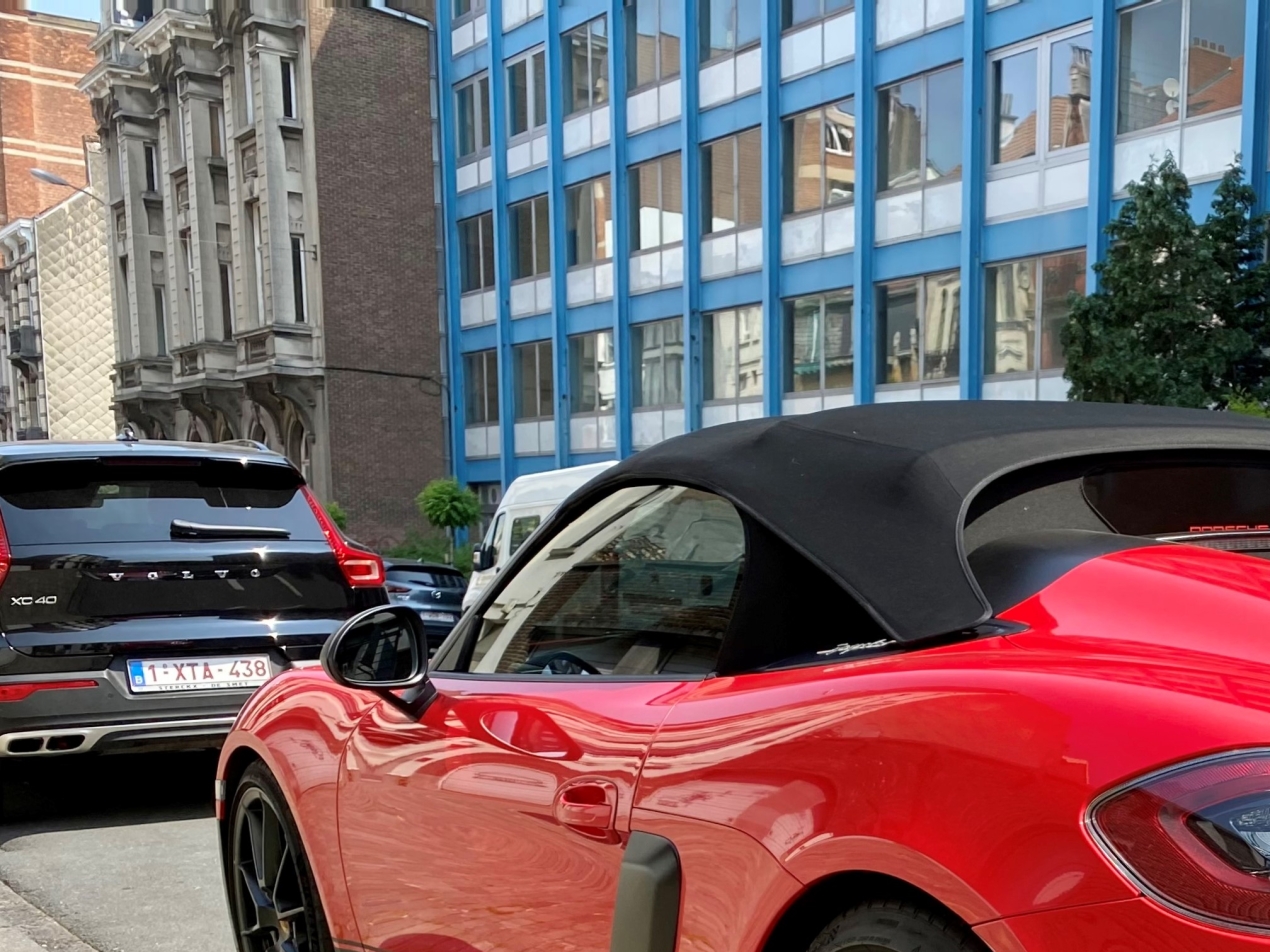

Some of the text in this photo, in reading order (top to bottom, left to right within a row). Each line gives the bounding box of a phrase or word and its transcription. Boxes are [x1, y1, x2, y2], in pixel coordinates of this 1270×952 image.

[109, 568, 262, 582] VOLVO
[147, 660, 267, 682] 1-XTA-438
[134, 675, 143, 684] B
